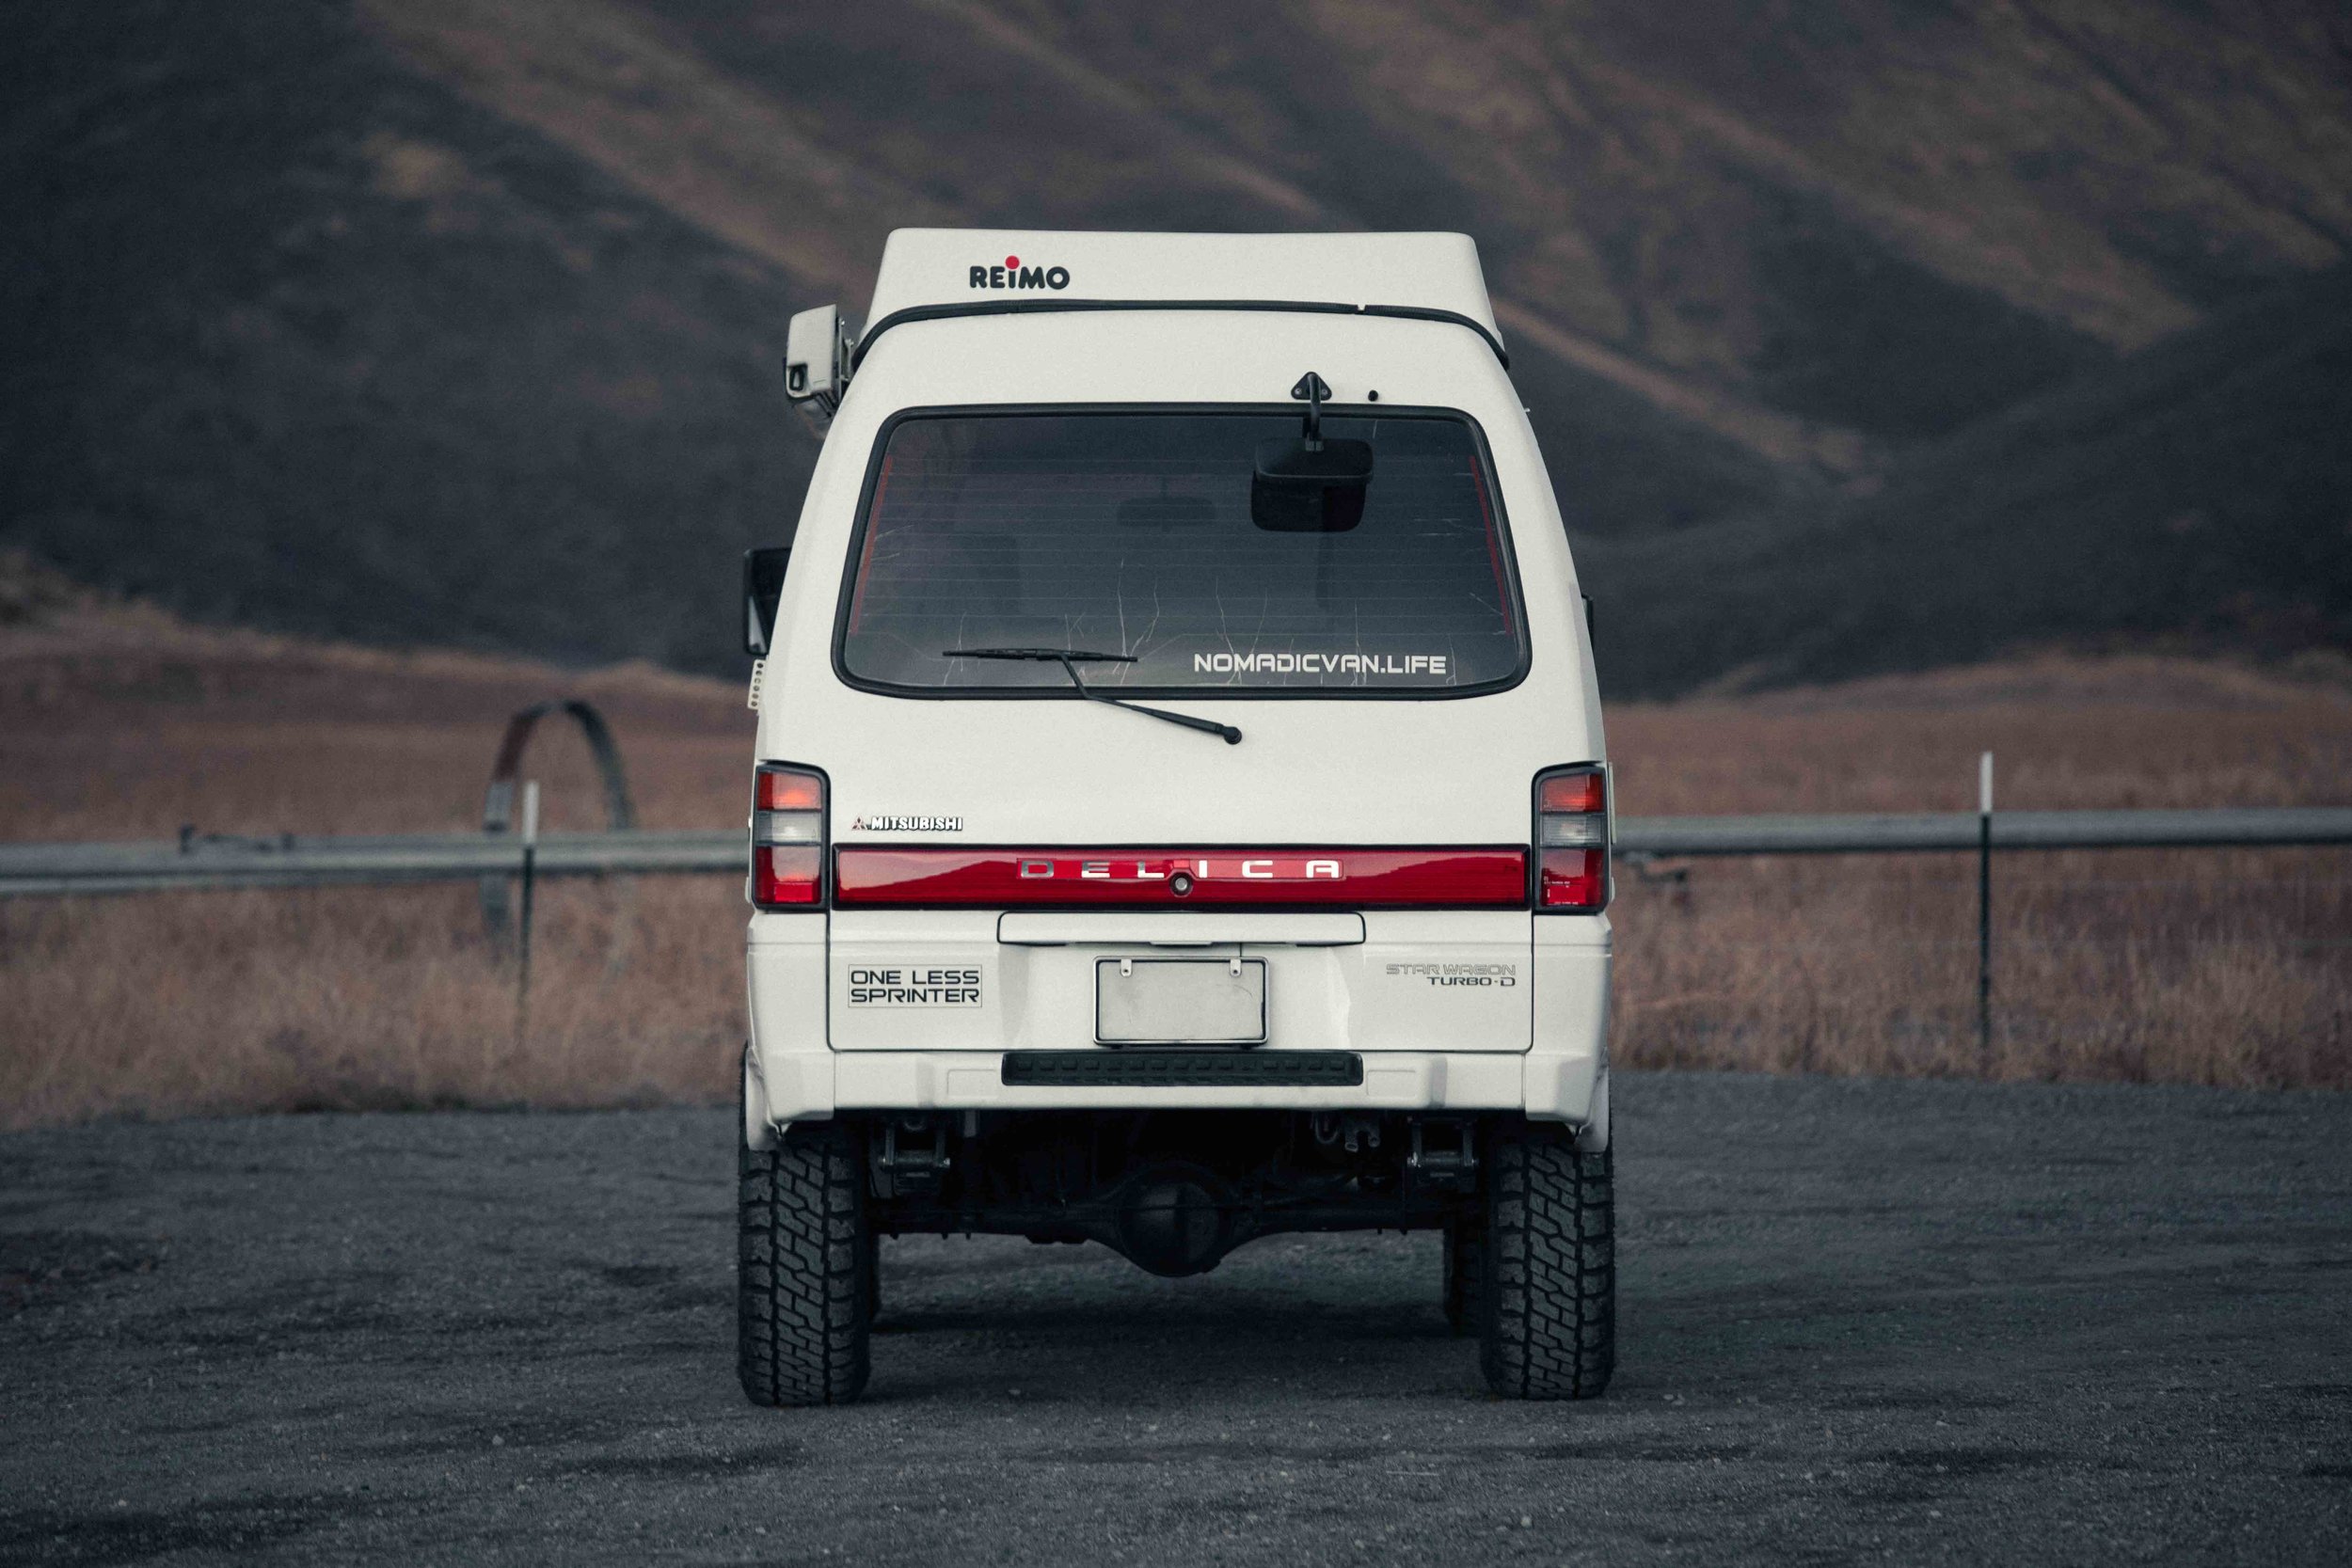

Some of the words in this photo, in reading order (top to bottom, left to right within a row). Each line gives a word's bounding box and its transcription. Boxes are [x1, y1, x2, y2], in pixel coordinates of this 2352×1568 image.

[1194, 653, 1447, 674] NOMADICVAN.LIFE
[870, 816, 962, 832] MITSUBISHI
[1020, 860, 1340, 879] DELICA
[1386, 963, 1440, 975] STAR
[1442, 964, 1516, 976] WAGON
[850, 970, 901, 985] ONE
[912, 970, 979, 985] LESS
[850, 989, 980, 1003] SPRINTER
